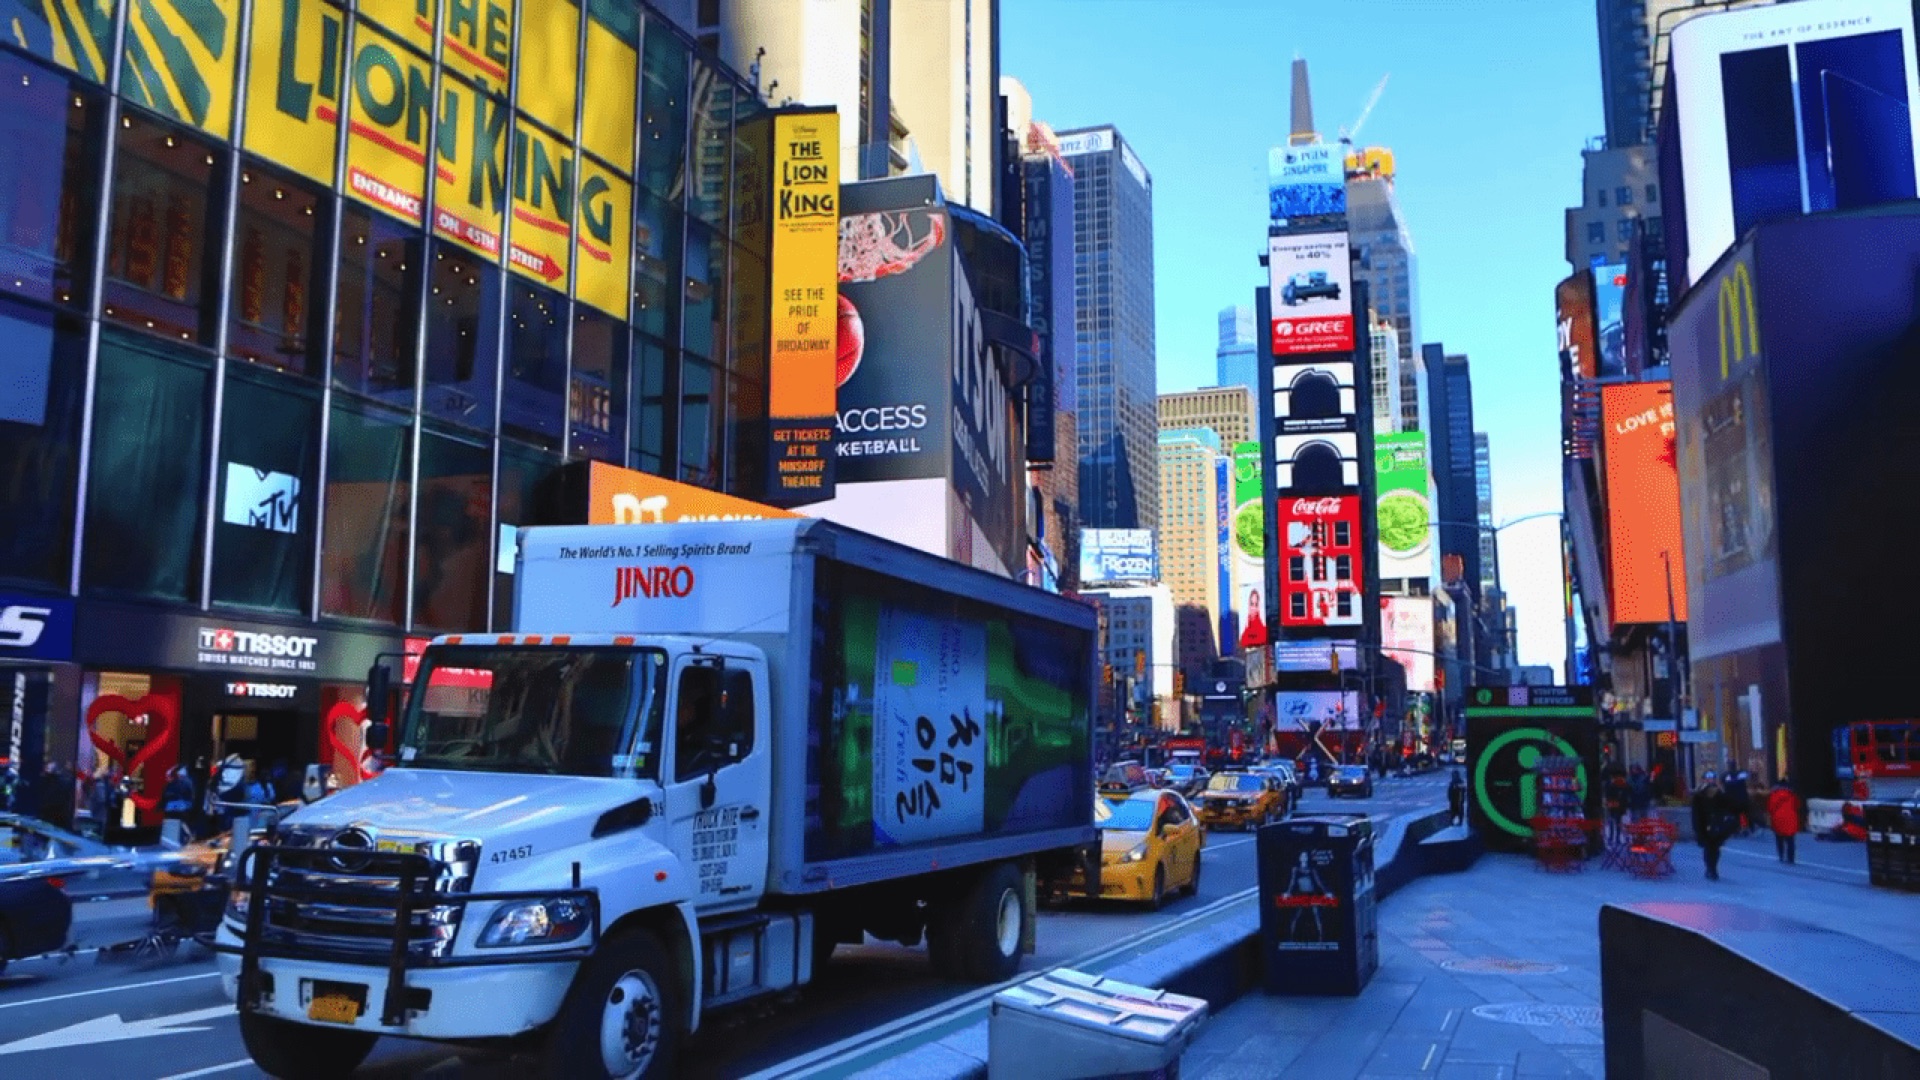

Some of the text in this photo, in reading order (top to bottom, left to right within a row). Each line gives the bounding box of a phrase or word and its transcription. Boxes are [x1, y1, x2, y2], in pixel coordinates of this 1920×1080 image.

[1743, 32, 1764, 40] THE
[276, 0, 613, 246] LION KING
[788, 140, 821, 156] THE
[782, 161, 828, 187] LION
[779, 189, 834, 219] KING
[351, 172, 422, 216] ENTRANCE
[437, 213, 460, 235] ON
[510, 248, 544, 273] STREET
[783, 288, 825, 301] SEE THE
[789, 305, 819, 318] PRIDE
[797, 322, 811, 335] OF
[1295, 320, 1344, 334] GREE
[776, 339, 831, 352] BROADWAY
[1615, 408, 1659, 435] LOVE
[773, 429, 831, 441] GET TICKETS
[834, 438, 921, 457] KETBALL
[559, 547, 577, 560] The
[580, 546, 616, 559] World's
[644, 544, 679, 560] Selling
[680, 543, 715, 559] Spirits
[717, 541, 752, 556] Brand
[611, 564, 694, 607] JINRO
[198, 652, 227, 663] SWISS
[229, 654, 269, 667] WATCHES
[272, 657, 296, 669] SINCE
[490, 844, 533, 864] 47457
